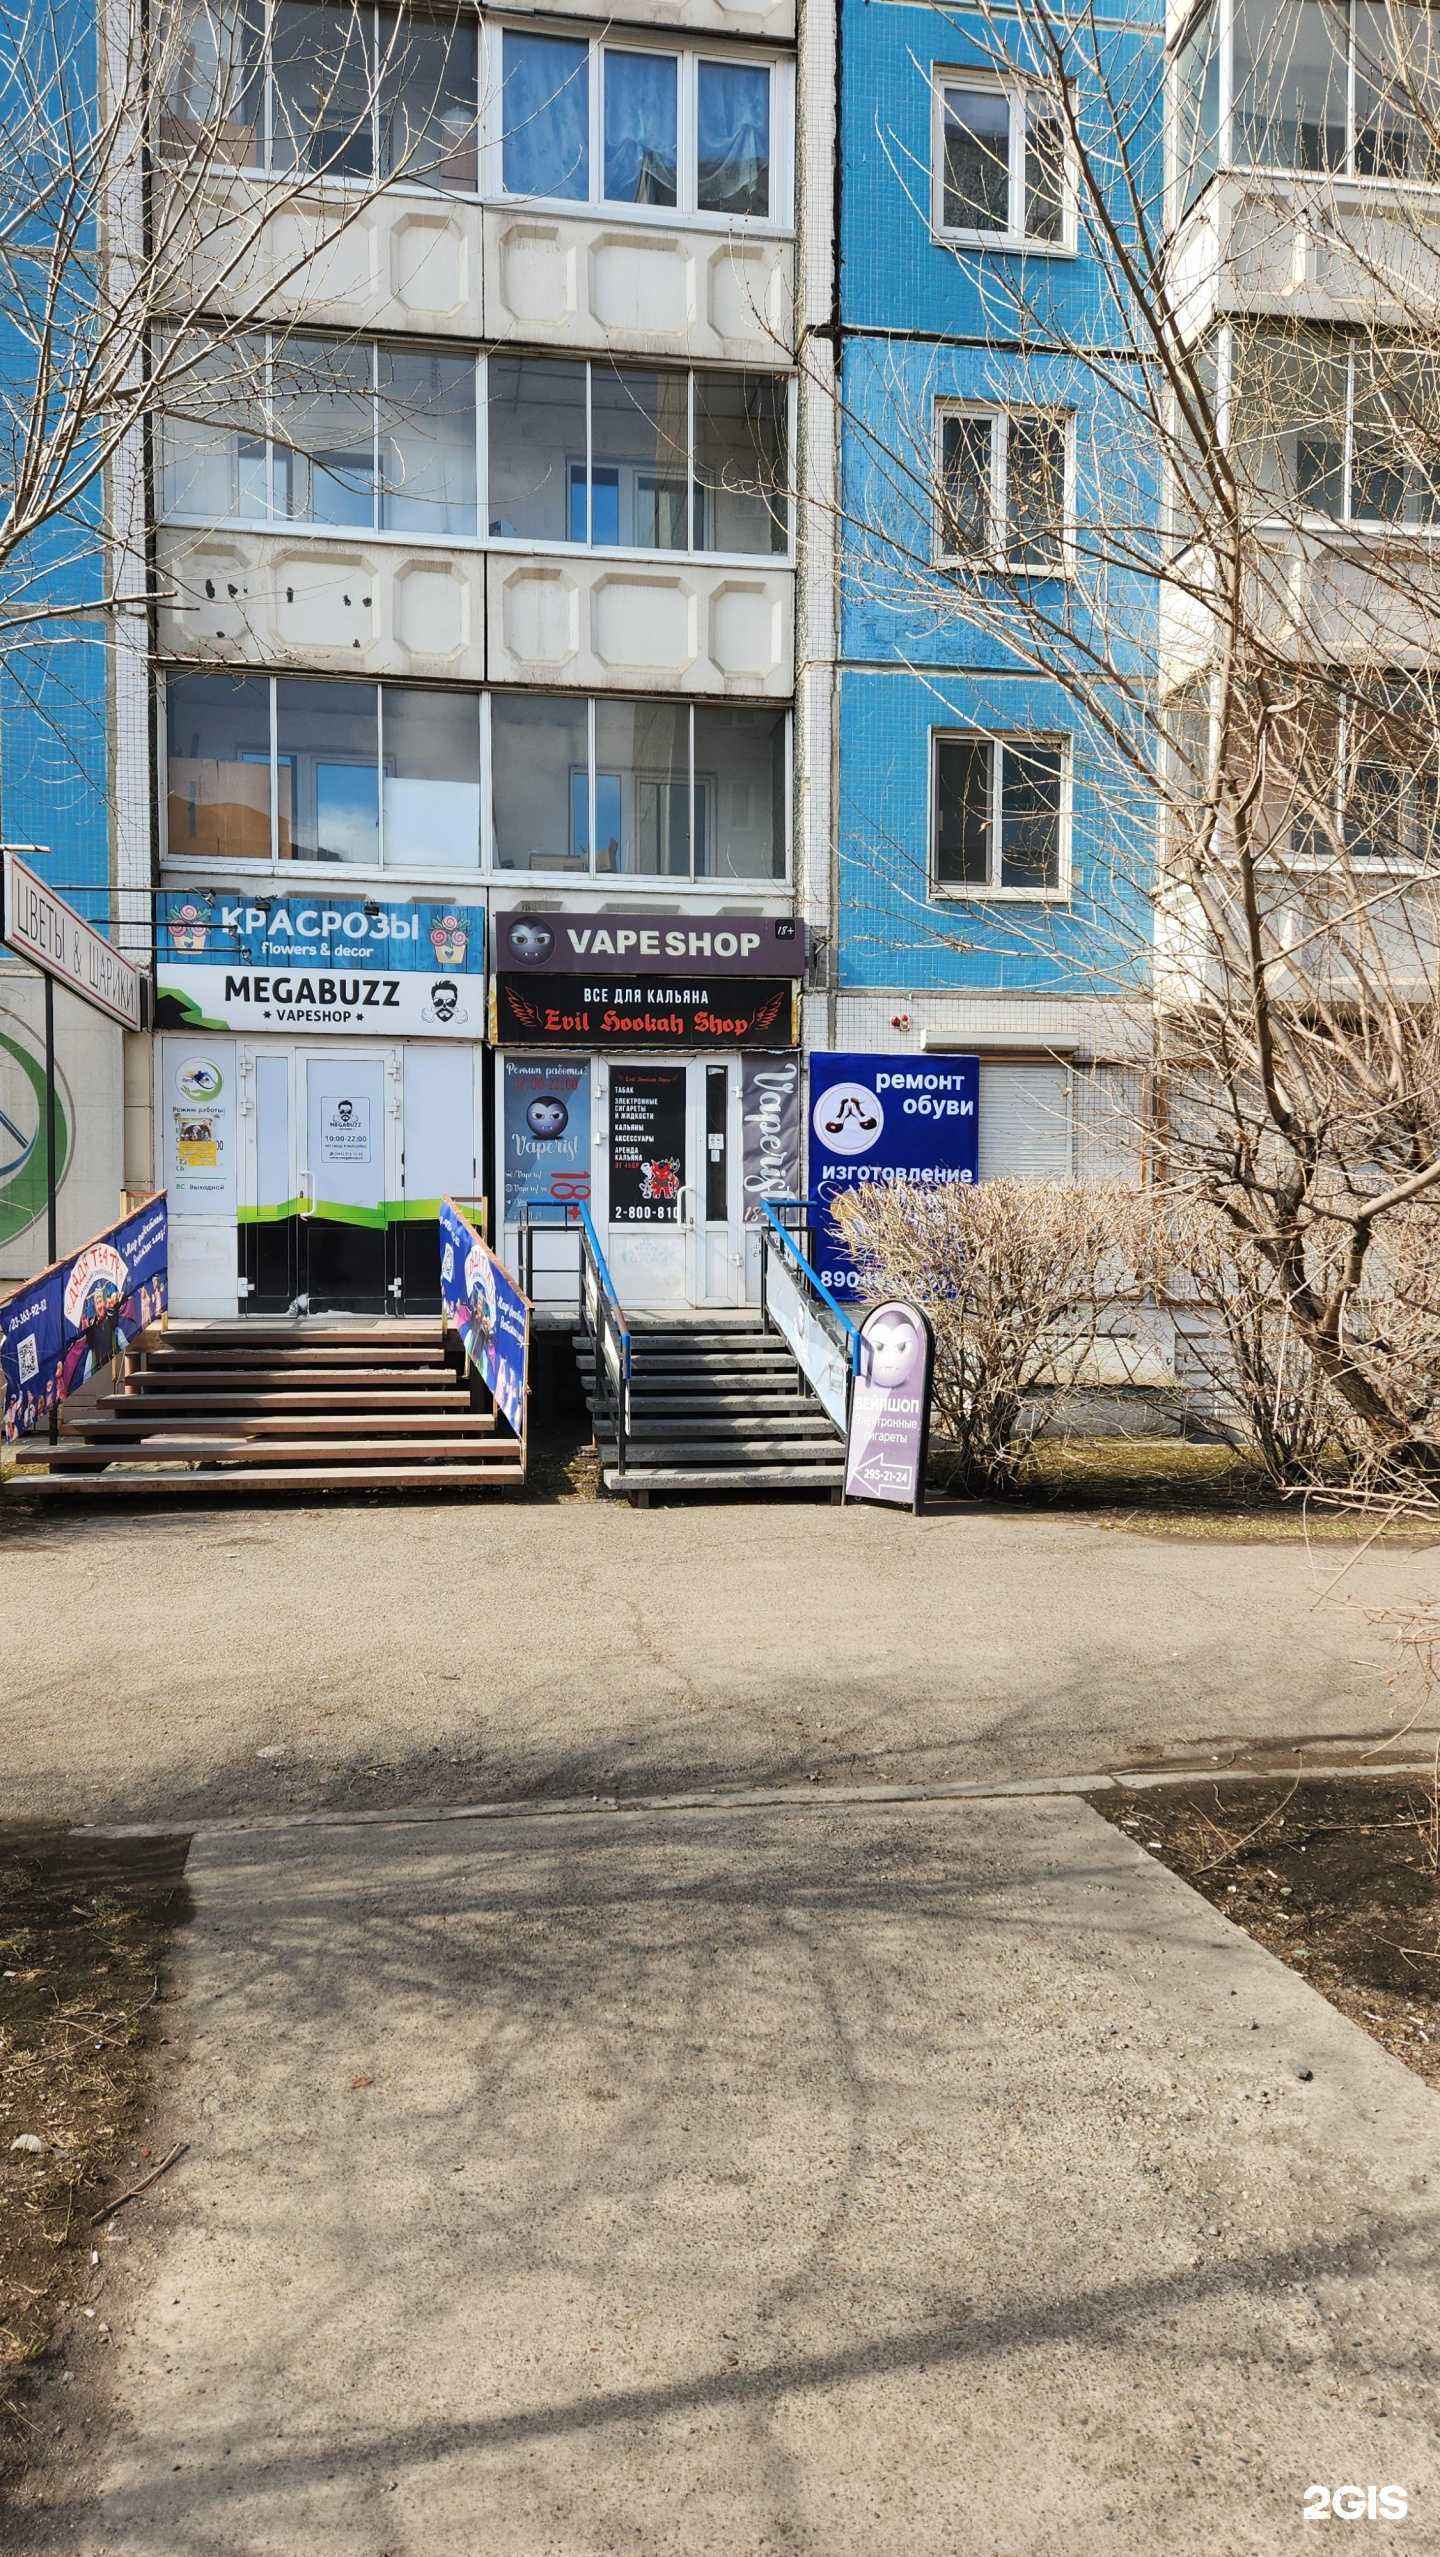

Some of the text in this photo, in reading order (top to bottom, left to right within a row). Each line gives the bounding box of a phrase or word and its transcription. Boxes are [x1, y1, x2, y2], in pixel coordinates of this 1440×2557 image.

[221, 906, 419, 940] КРАСРОЗЫ
[777, 925, 795, 936] 18+
[17, 877, 136, 1014] ЦВЕТЫ & ШАРИКИ
[261, 942, 374, 957] flowers & decor
[225, 975, 400, 1007] MEGABUZZ
[583, 988, 709, 1004] ВСЕ ДЛЯ КАЛЬЯНА
[276, 1009, 352, 1023] VAPESHOP
[543, 1008, 750, 1035] Evil Hookah Shop
[876, 1072, 965, 1093] ремонт
[614, 1097, 658, 1105] ЭЛЕКТРОННЫЕ
[902, 1095, 974, 1120] обуви
[614, 1123, 644, 1131] КАЛЬЯНЫ
[822, 1165, 973, 1183] изготовление
[863, 1468, 908, 1483] 295-21-24
